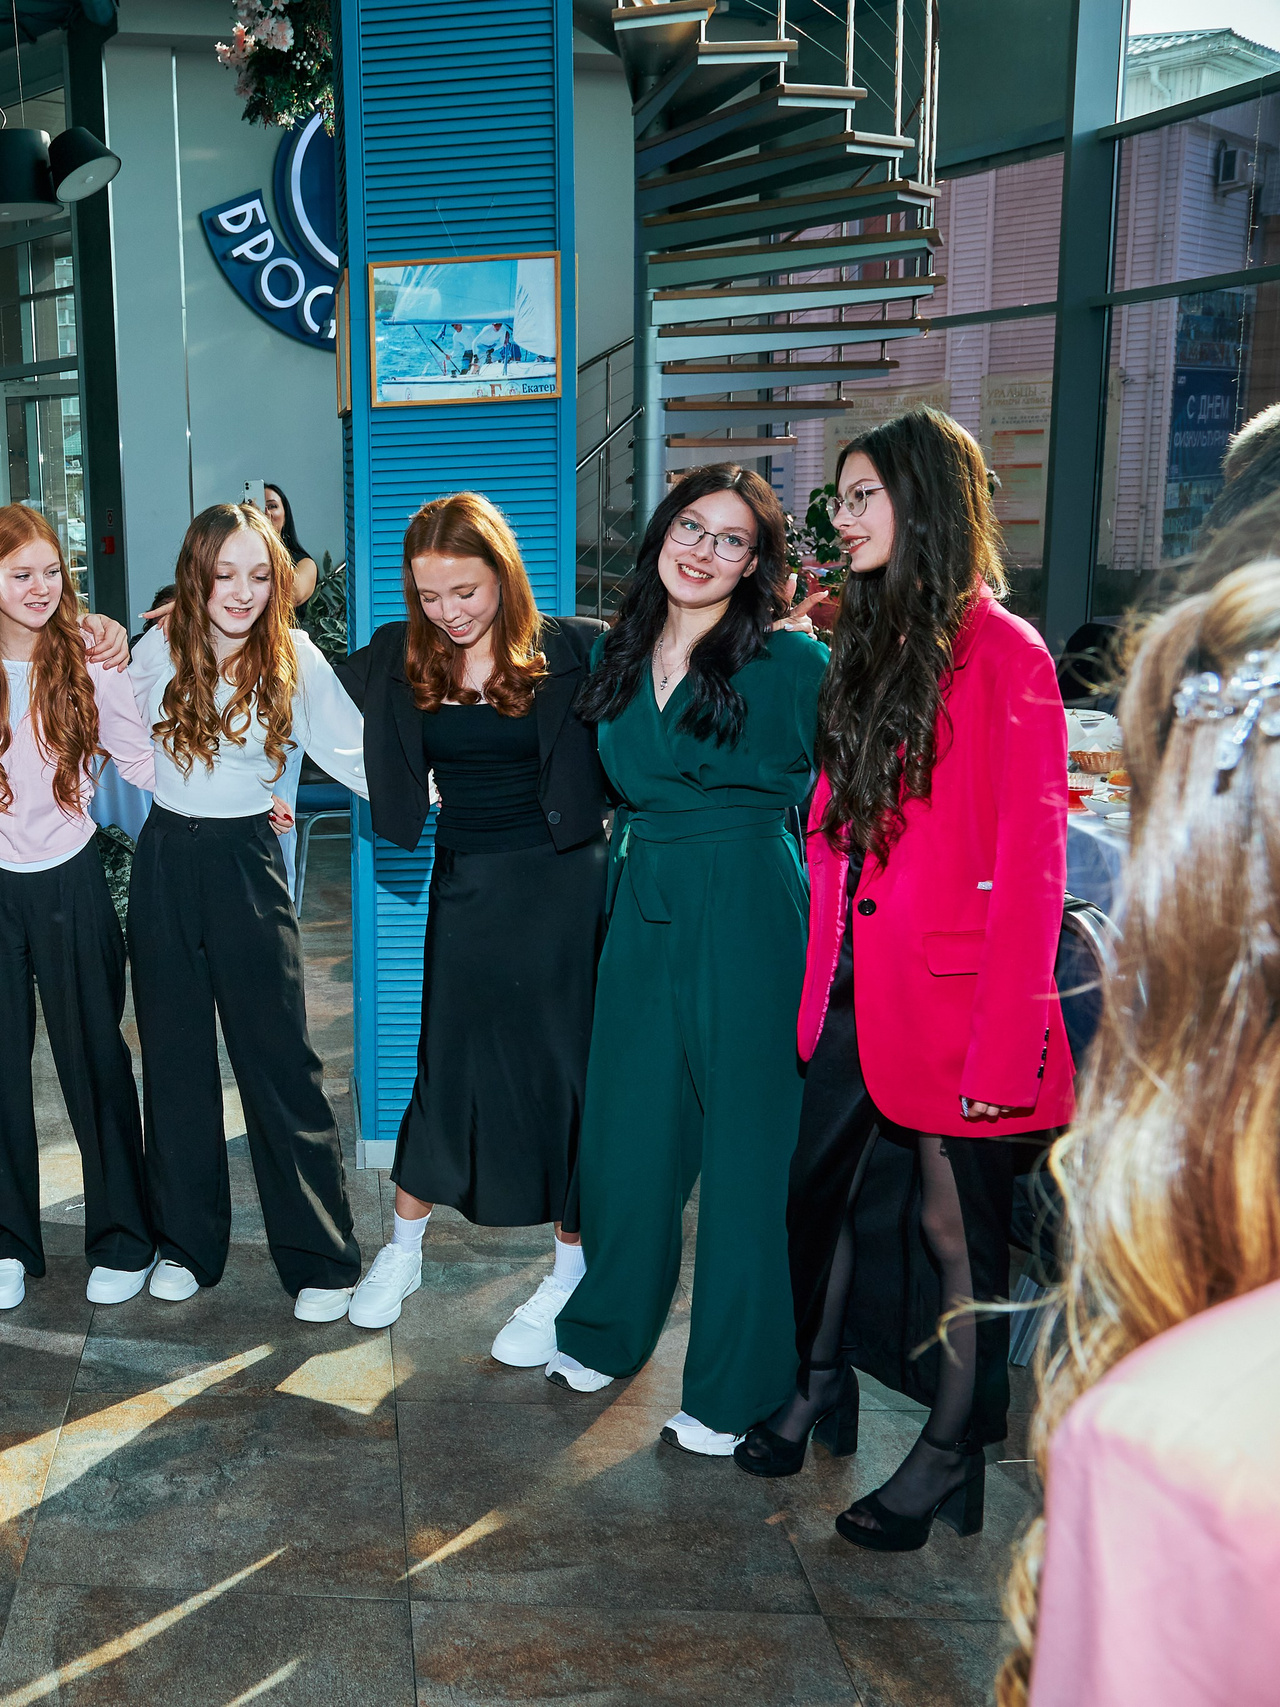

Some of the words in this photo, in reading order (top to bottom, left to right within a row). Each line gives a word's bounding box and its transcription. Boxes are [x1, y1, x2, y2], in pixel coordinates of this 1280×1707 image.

[218, 199, 337, 339] БРОС
[522, 383, 556, 394] Екатер
[987, 386, 1037, 399] УРАЛЬЦЫ
